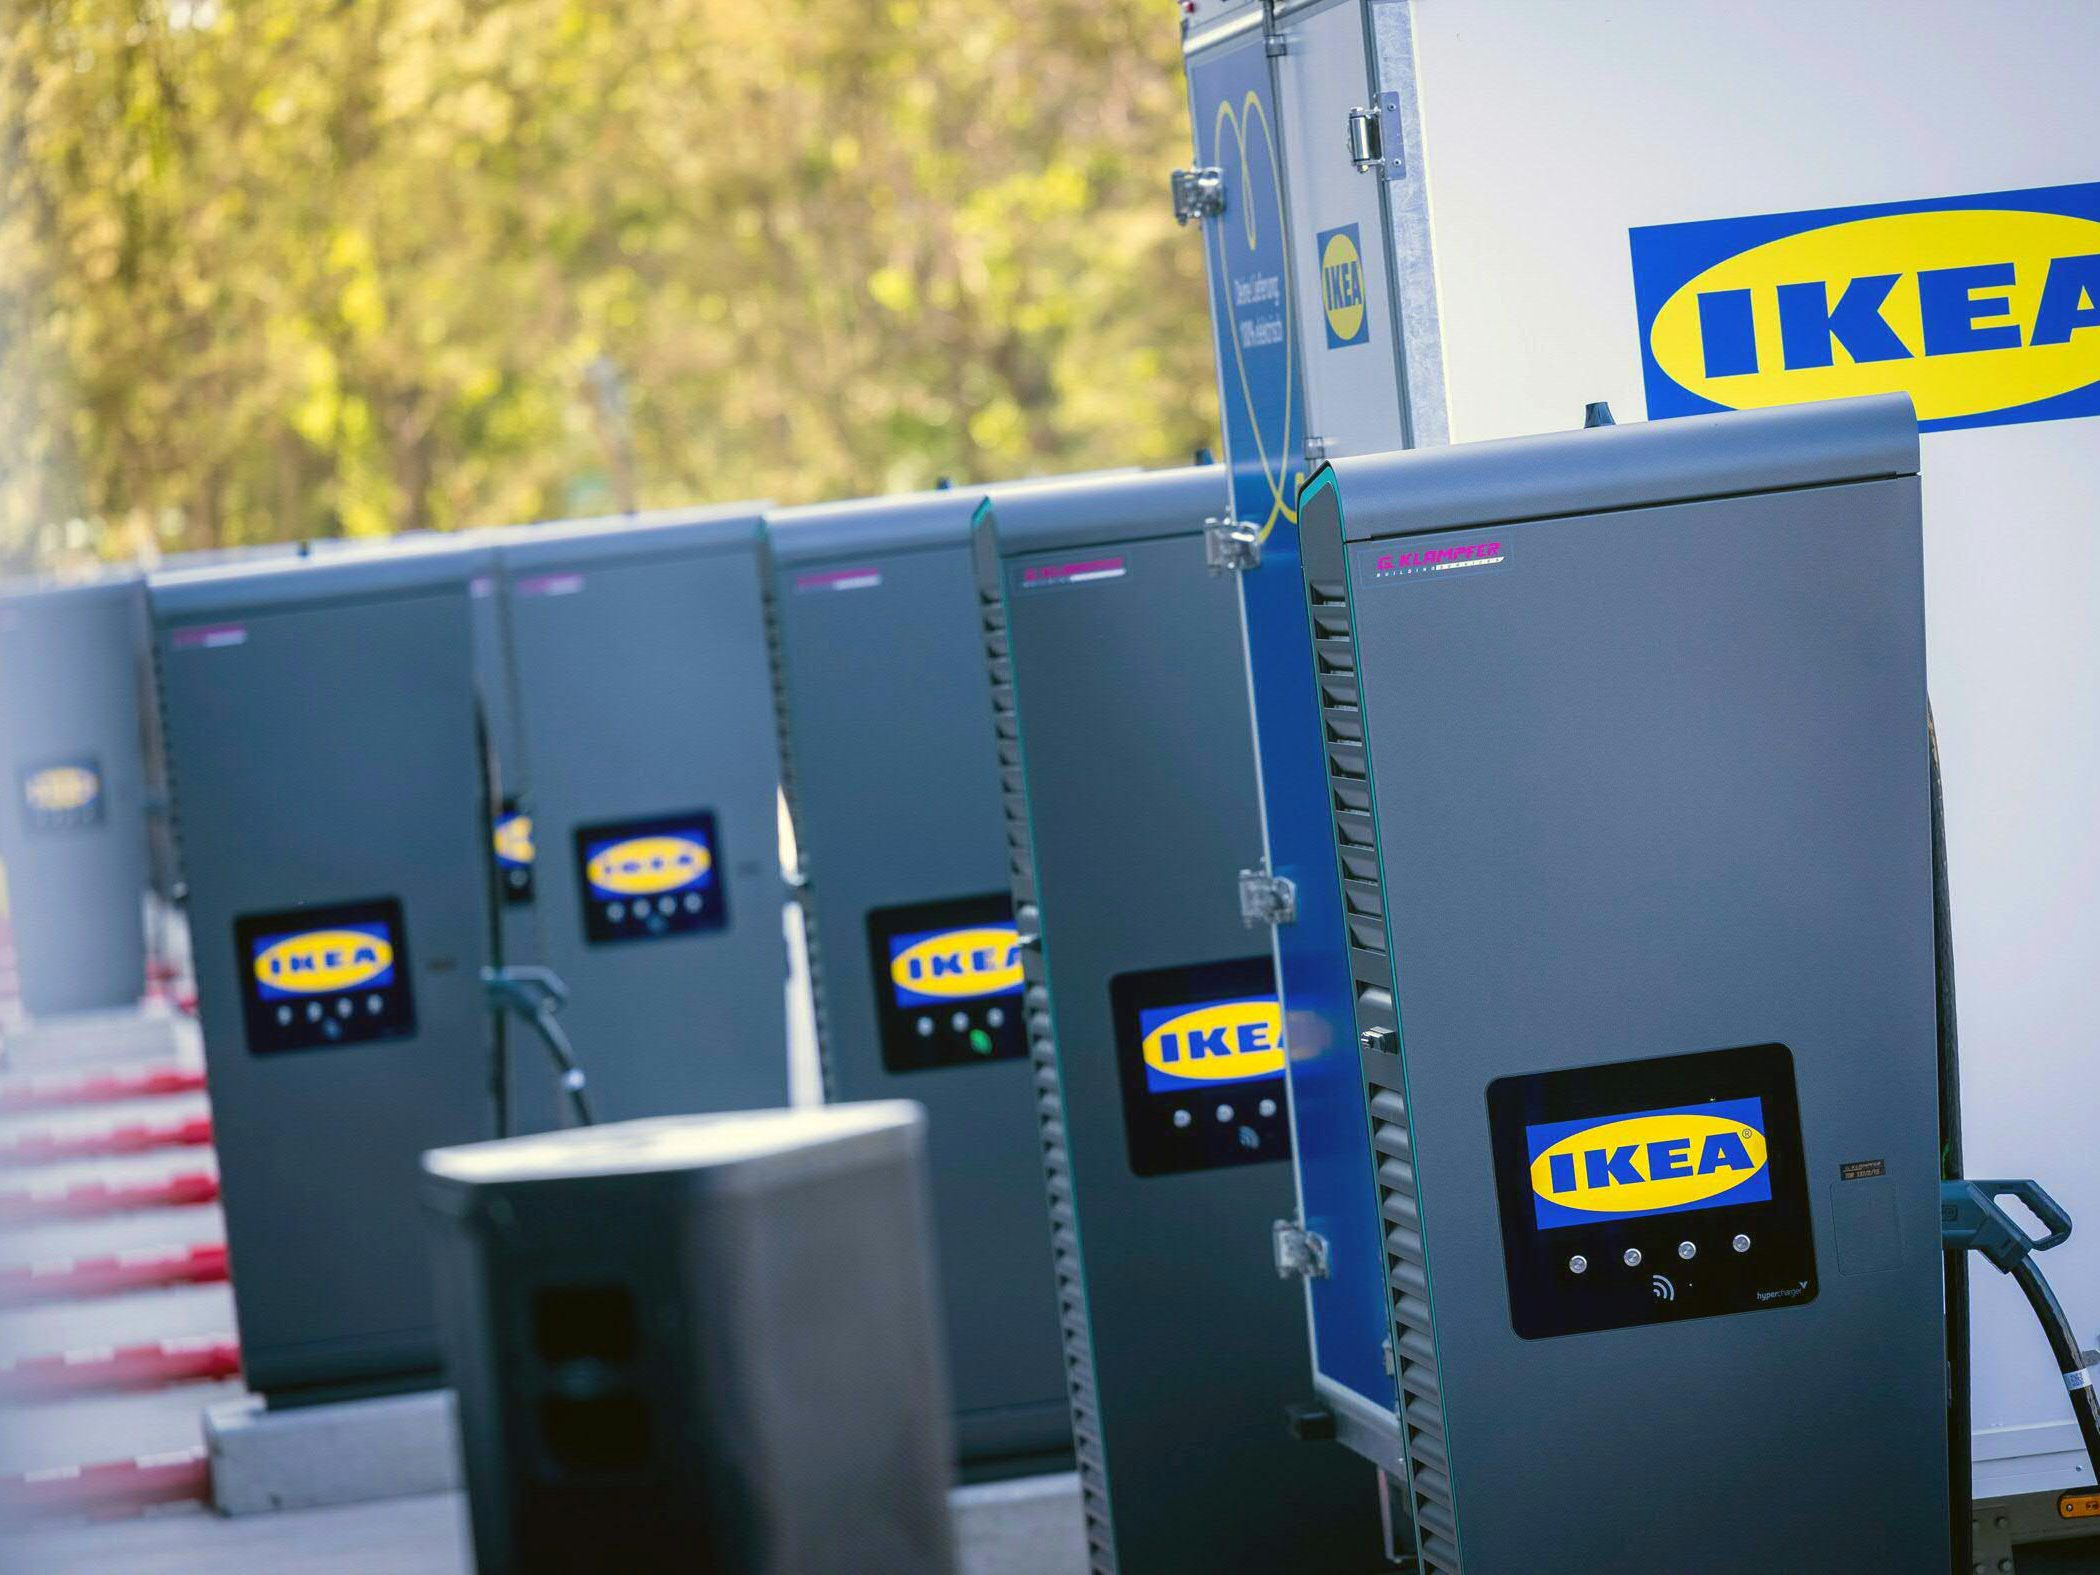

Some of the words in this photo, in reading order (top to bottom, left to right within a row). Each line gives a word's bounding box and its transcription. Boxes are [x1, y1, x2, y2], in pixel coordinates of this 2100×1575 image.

[1325, 260, 1362, 311] IKEA
[1696, 253, 2100, 379] IKEA
[1159, 1020, 1285, 1064] IKE
